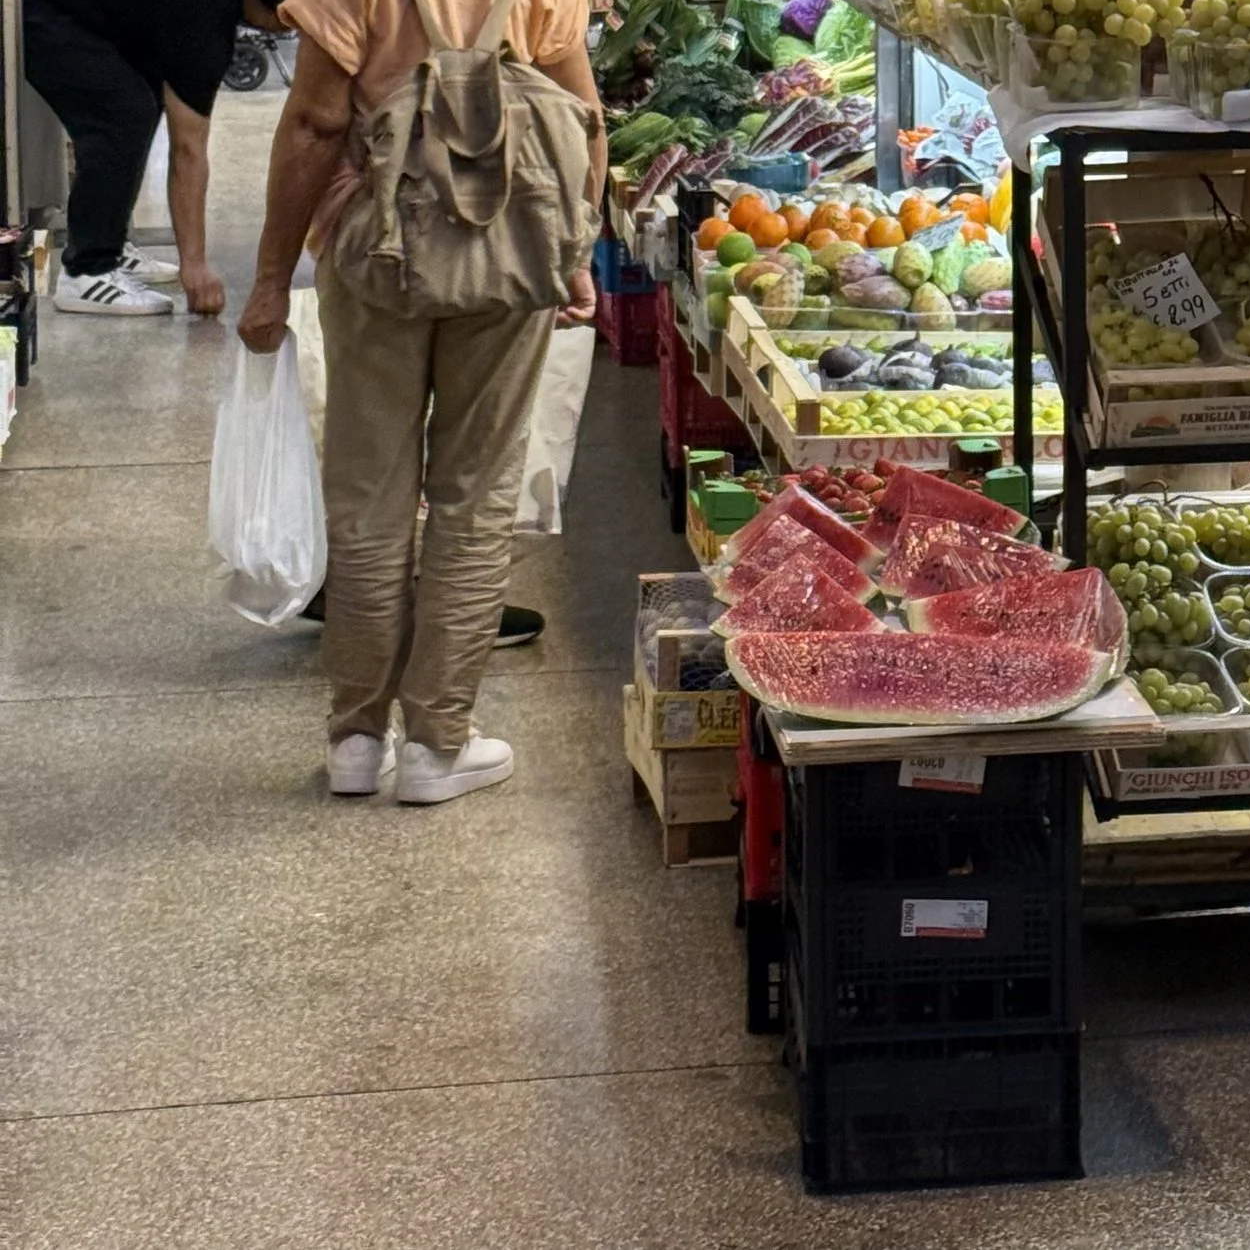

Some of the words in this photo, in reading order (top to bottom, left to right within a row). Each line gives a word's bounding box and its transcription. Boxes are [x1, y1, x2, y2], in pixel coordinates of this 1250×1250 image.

[1142, 286, 1158, 309] 5
[1180, 410, 1236, 424] FAMIGLIA
[1131, 769, 1215, 788] GIUNCHI
